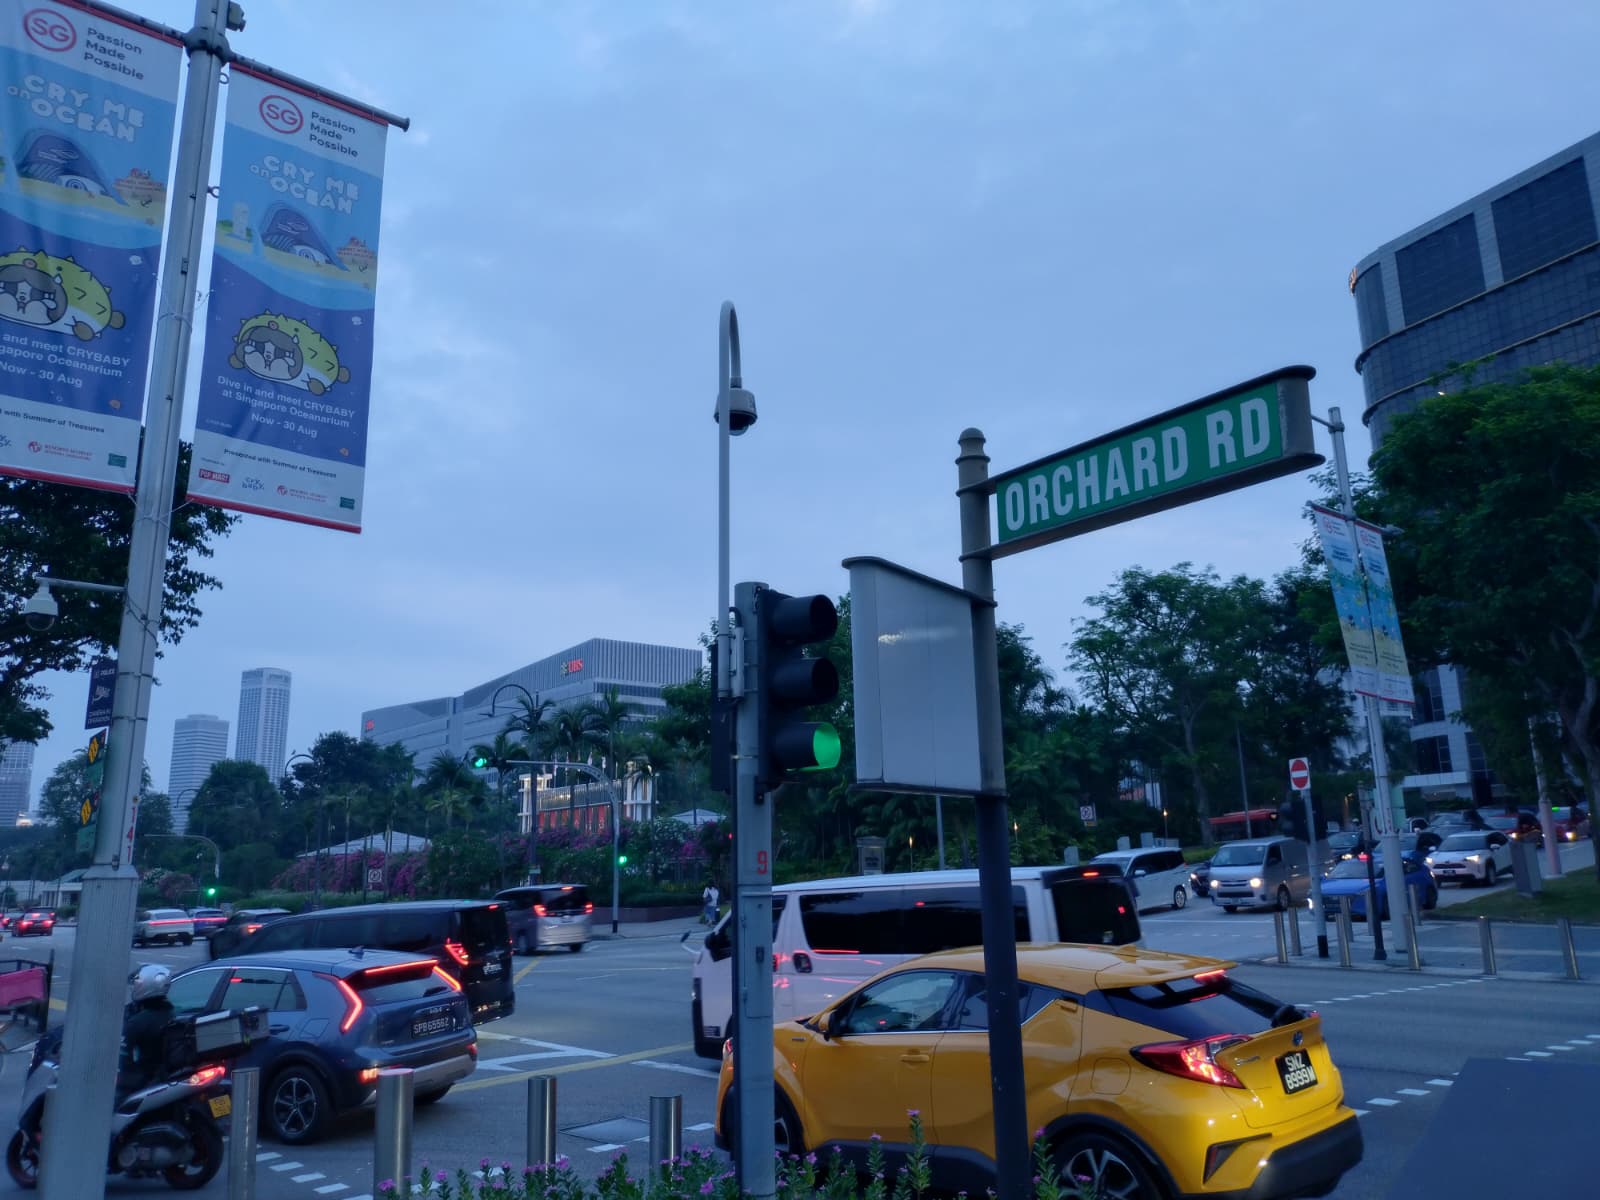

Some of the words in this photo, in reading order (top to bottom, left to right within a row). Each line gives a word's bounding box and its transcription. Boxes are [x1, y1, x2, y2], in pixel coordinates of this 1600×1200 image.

[31, 17, 70, 42] SG
[87, 27, 143, 54] Passion
[86, 39, 126, 60] Made
[83, 52, 145, 80] Possible
[24, 74, 89, 108] CRY
[103, 99, 144, 128] ME
[265, 103, 298, 125] SG
[31, 98, 135, 143] OCEAN
[310, 122, 342, 140] Made
[311, 111, 356, 134] Passion
[309, 133, 359, 157] Possible
[263, 155, 314, 184] CRY
[326, 177, 358, 200] ME
[270, 176, 352, 214] OCEAN
[2, 334, 28, 345] and
[31, 339, 63, 353] meet
[66, 345, 131, 367] CRYBABY
[0, 361, 27, 375] Now
[39, 369, 54, 380] 30
[57, 373, 83, 388] Aug
[47, 353, 122, 377] Oceanarium
[217, 375, 241, 390] Dive
[243, 382, 252, 394] in
[254, 388, 274, 399] and
[276, 393, 301, 405] meet
[303, 400, 356, 418] CRYBABY
[222, 388, 233, 398] at
[235, 391, 287, 413] Singapore
[289, 406, 350, 428] Oceanarium
[251, 413, 274, 425] Now
[283, 420, 295, 431] 30
[298, 424, 318, 439] Aug
[1004, 425, 1188, 531] ORCHARD
[1204, 397, 1271, 468] RD
[757, 850, 768, 875] 9
[1285, 1053, 1305, 1072] SNZ
